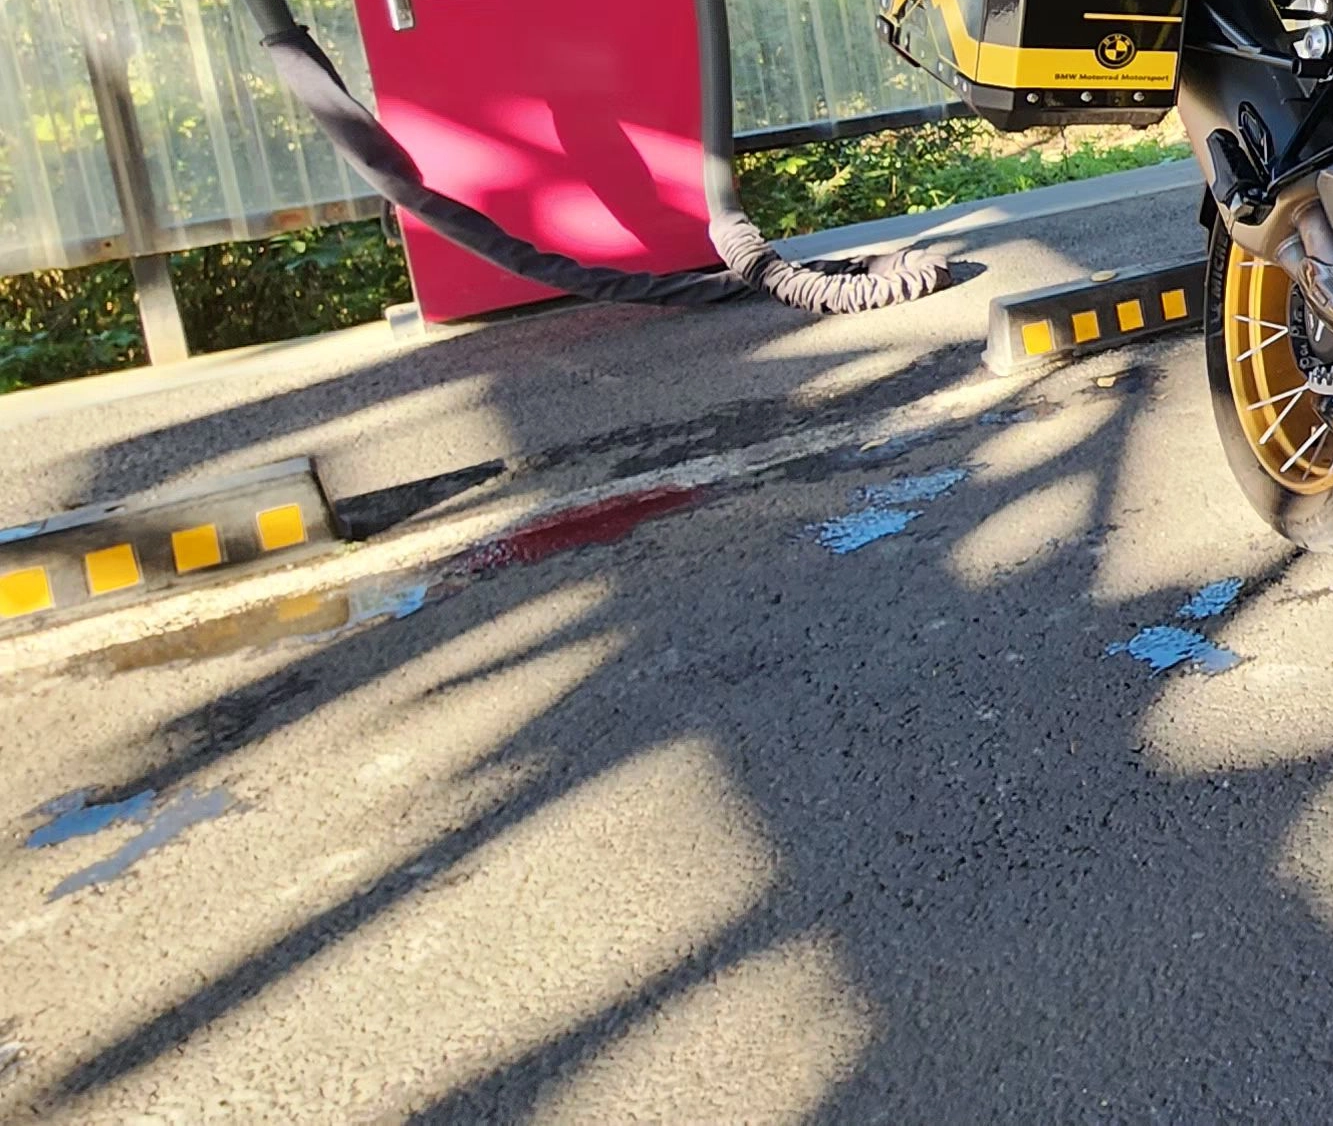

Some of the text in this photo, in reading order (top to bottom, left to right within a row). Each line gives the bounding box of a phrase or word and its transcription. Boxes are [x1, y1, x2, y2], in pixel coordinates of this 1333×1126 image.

[1055, 73, 1169, 82] BMW Motorrad Motorsport
